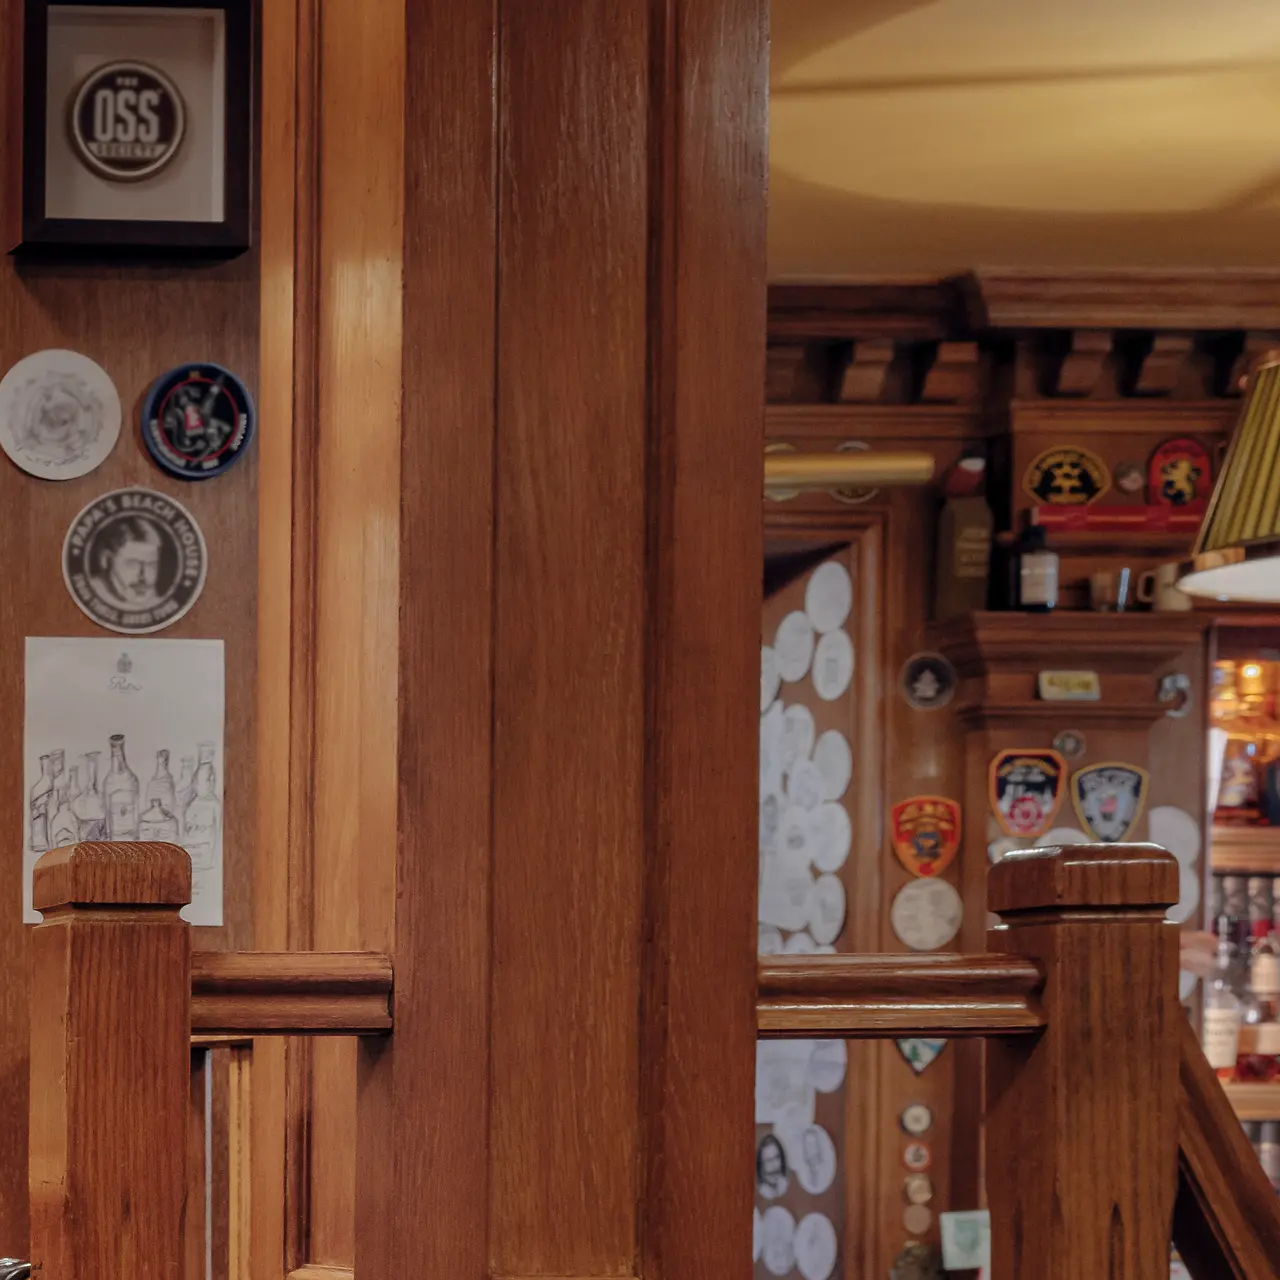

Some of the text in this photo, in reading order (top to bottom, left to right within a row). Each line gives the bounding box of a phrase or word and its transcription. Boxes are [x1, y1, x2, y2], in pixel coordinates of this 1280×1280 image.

[94, 88, 160, 142] OSS
[71, 494, 199, 576] PAPA'S BEACH HOUSE
